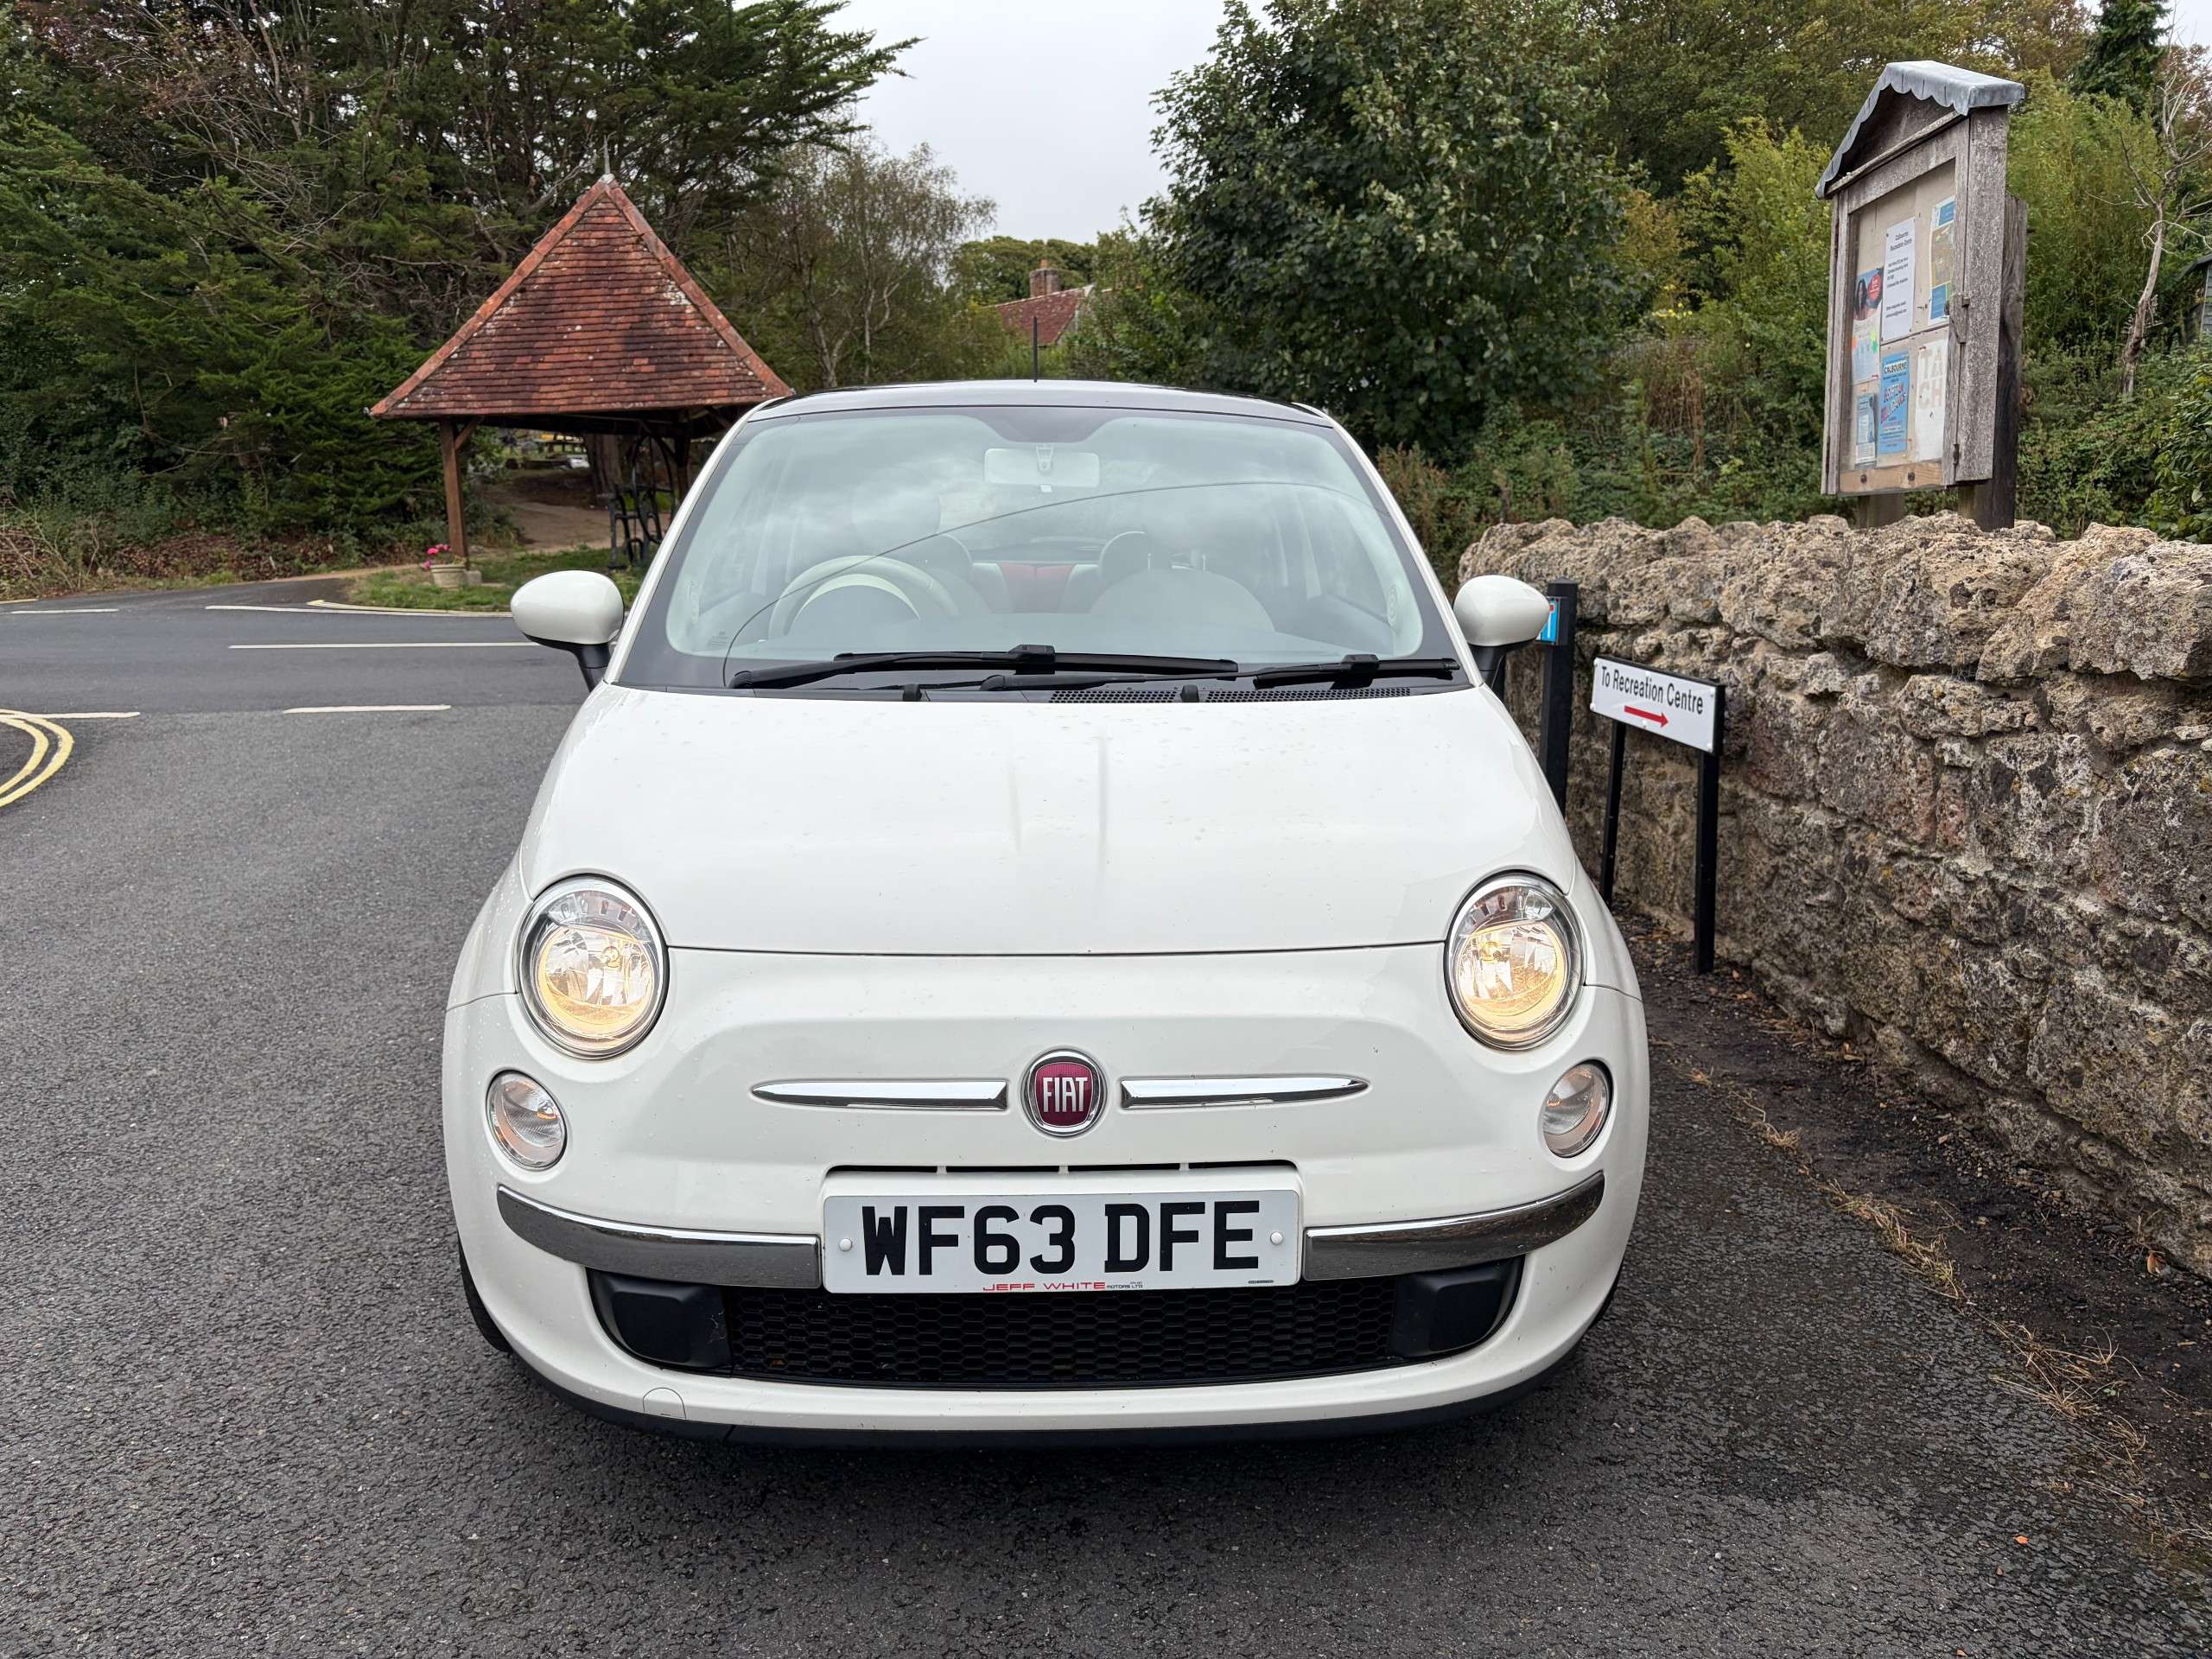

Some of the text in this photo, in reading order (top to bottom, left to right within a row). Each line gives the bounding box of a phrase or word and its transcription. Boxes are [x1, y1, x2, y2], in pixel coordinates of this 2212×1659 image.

[1601, 666, 1703, 715] To Recreation Centre
[1042, 1077, 1089, 1113] FIAT
[861, 1200, 1260, 1276] WF63 DFE
[1044, 1281, 1106, 1290] WHITE
